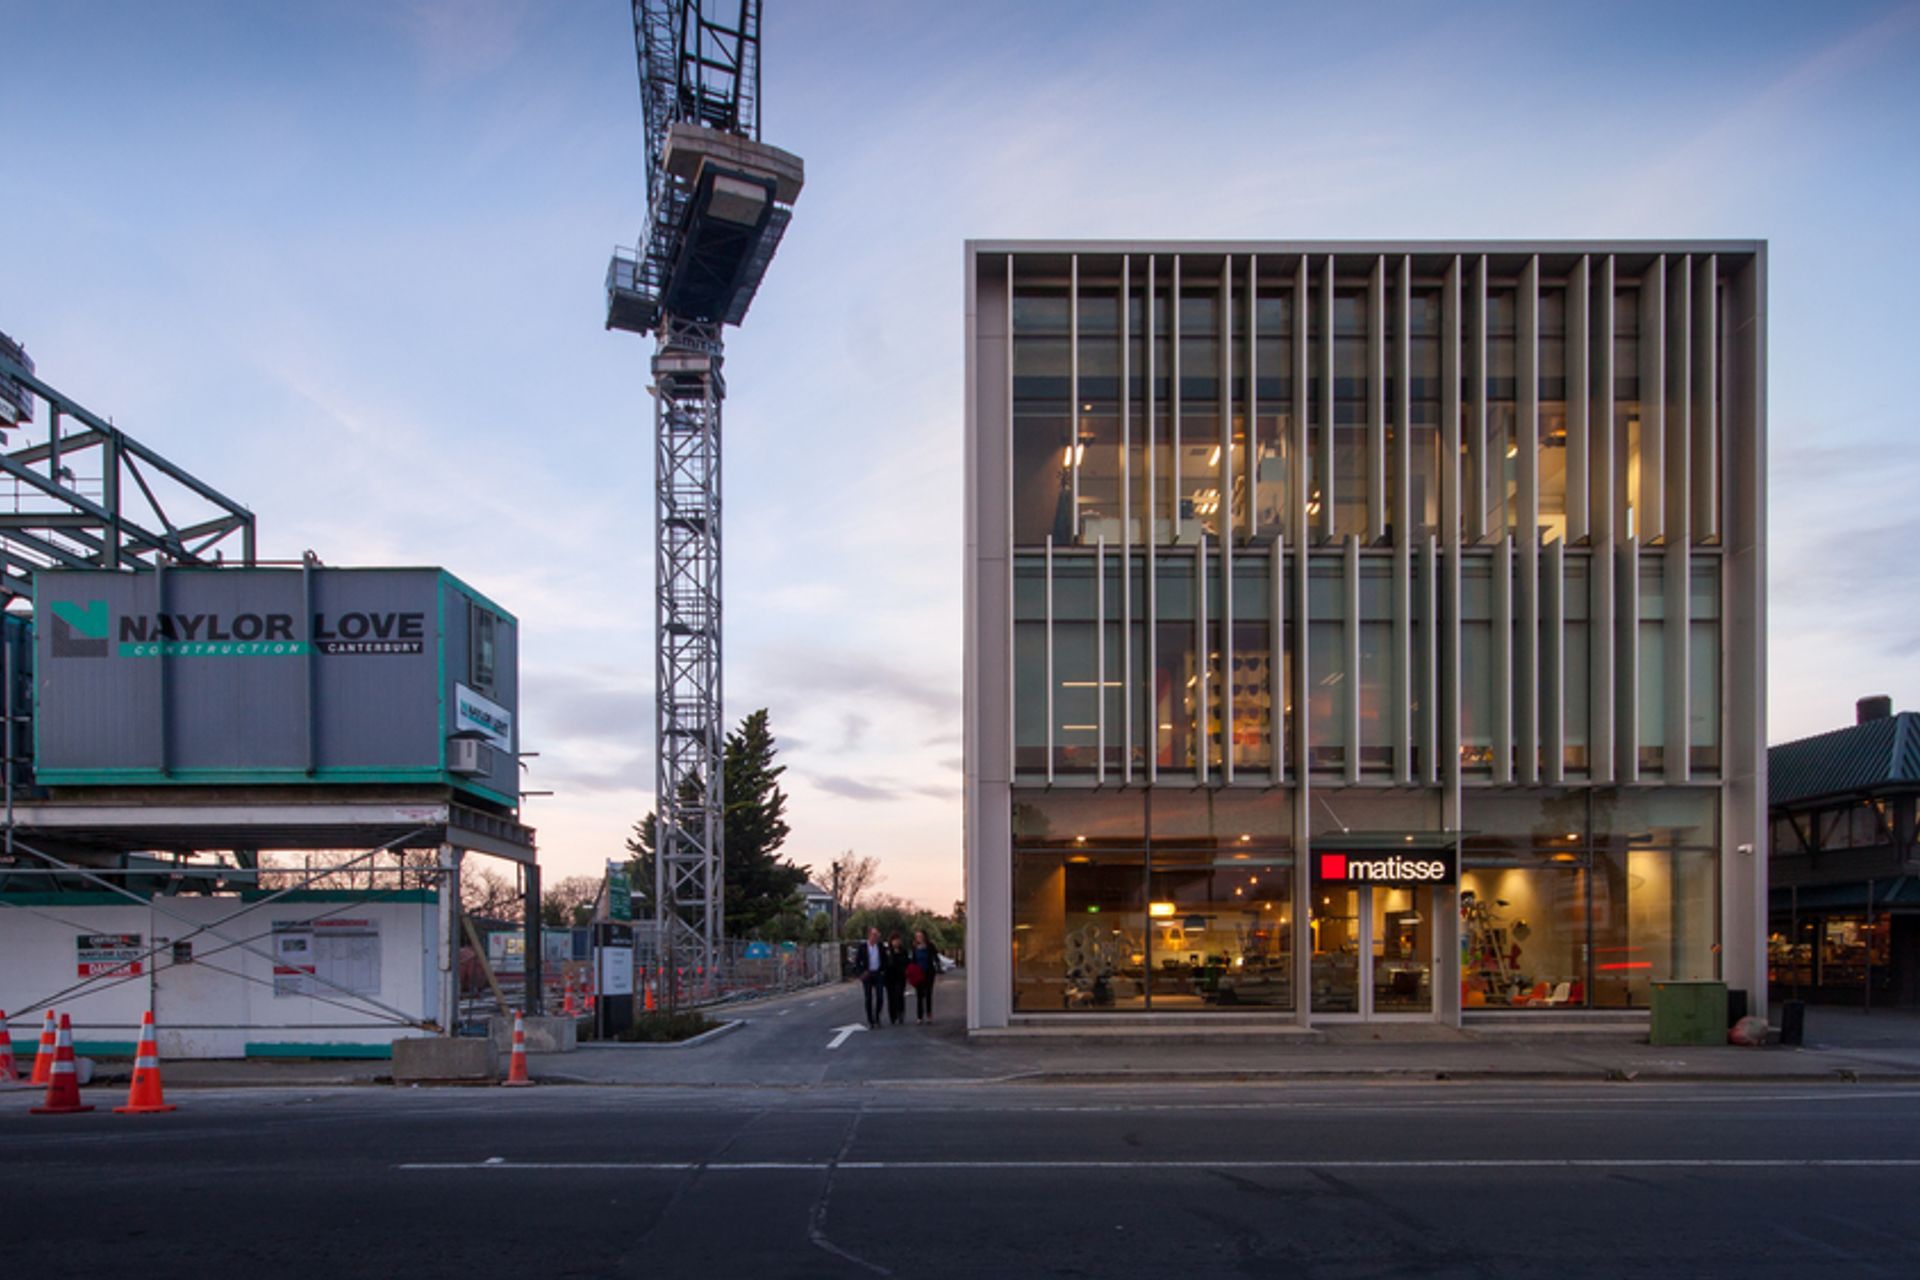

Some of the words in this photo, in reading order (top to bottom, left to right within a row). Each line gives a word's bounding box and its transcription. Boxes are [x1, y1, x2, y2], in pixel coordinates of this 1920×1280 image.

[119, 613, 295, 641] NAYLOR
[314, 612, 424, 639] LOVE
[133, 643, 299, 656] CONSTRUCTION
[327, 643, 420, 653] CANTERBURY
[1348, 855, 1445, 879] matisse
